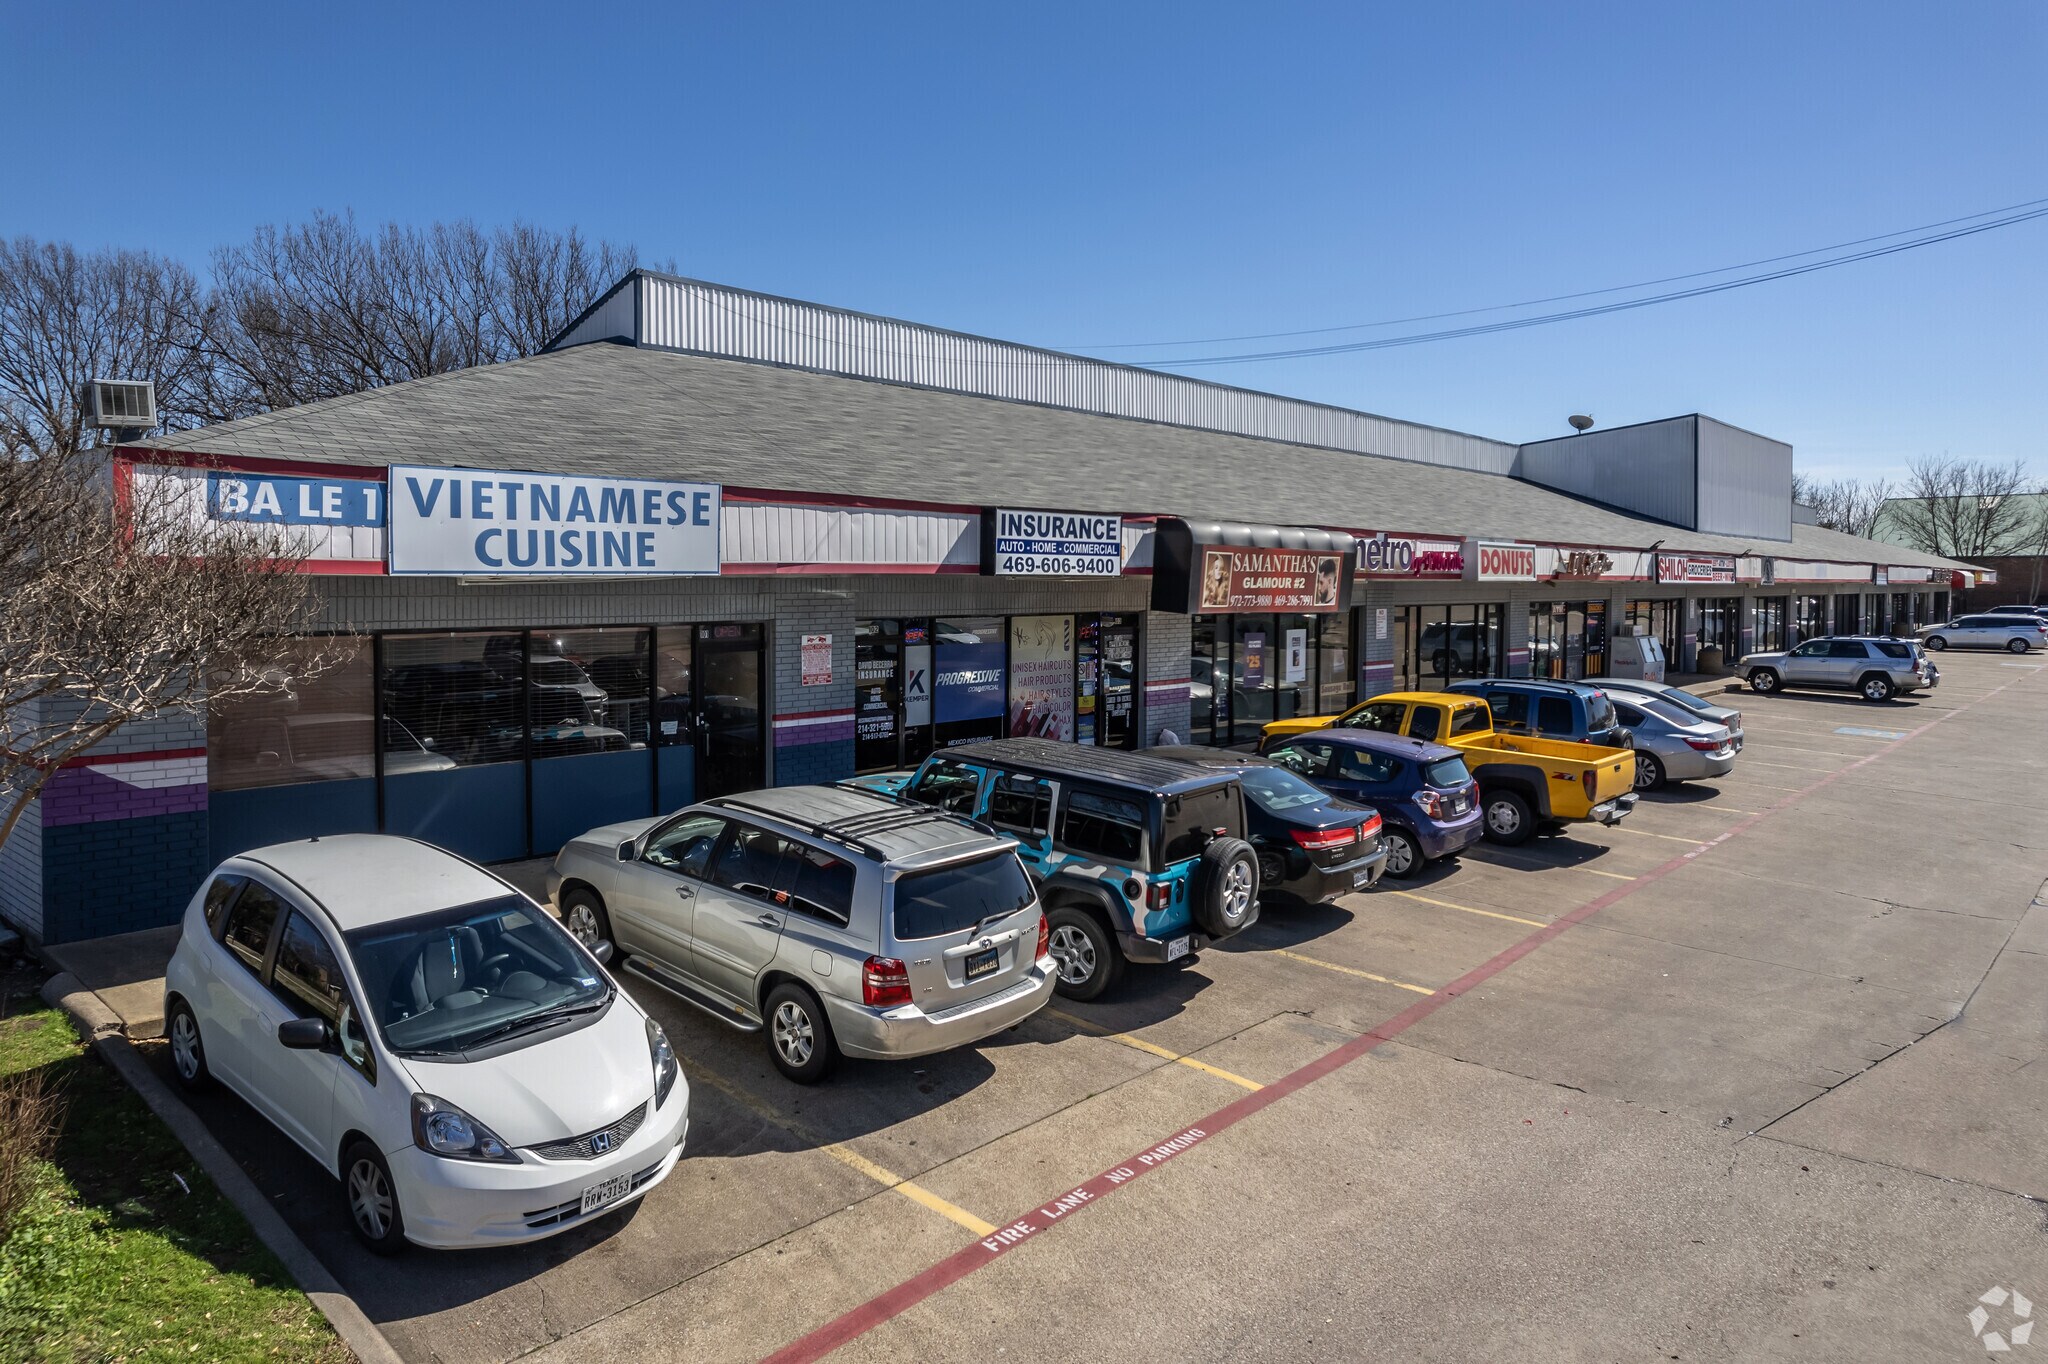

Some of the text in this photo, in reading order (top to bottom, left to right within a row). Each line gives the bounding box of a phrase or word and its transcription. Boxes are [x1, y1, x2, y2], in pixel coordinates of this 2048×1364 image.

[219, 479, 378, 521] BA LE 1
[405, 476, 711, 527] VIETNAMESE
[1000, 513, 1118, 541] INSURANCE
[474, 528, 657, 568] CUISINE
[1000, 541, 1118, 555] AUTO HOME COMMERCIAL
[1003, 556, 1115, 574] 469-606-9400
[1233, 553, 1317, 574] SAMANTHA'S
[1480, 549, 1533, 576] DONUTS
[1658, 557, 1687, 581] SHILOH
[1687, 564, 1712, 576] GROCERIES
[1242, 577, 1306, 589] GLAMOUR #2
[714, 626, 742, 638] OPEN
[858, 660, 894, 670] DAVID BECERRA
[1012, 660, 1072, 673] UNISEX HAIRCUTS
[858, 669, 894, 680] INSURANCE
[935, 669, 1002, 687] PROGRESSIVE
[1018, 674, 1072, 687] HAIR PRODUCTS
[967, 684, 999, 693] COMMERCIAL
[1028, 687, 1072, 701] HAIR STYLES
[904, 694, 930, 703] KEMPER
[863, 702, 888, 711] COMMERCIAL
[1032, 700, 1072, 714] HAIR COLOR
[947, 735, 993, 747] MEXICO INSURANCE
[1551, 771, 1577, 782] Z71
[598, 1176, 619, 1189] TEXAS
[981, 1127, 1207, 1252] FIRE LANE NO PARKING
